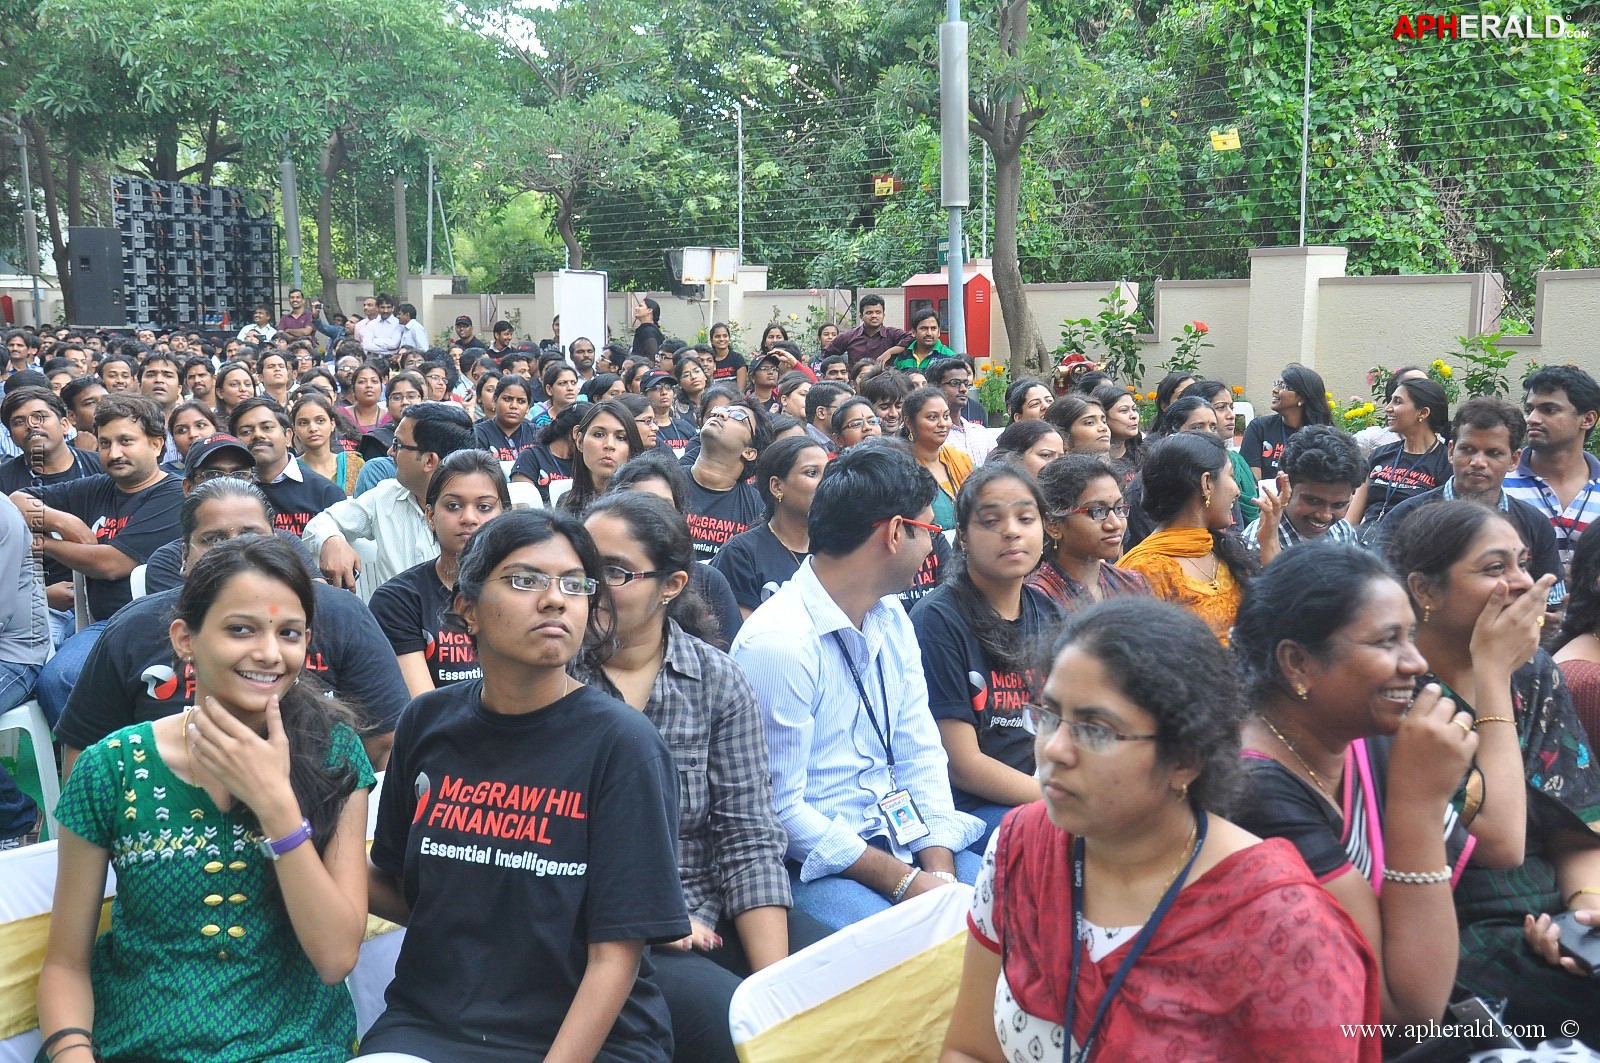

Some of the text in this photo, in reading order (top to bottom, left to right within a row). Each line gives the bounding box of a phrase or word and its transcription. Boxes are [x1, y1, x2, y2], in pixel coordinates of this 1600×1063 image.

[438, 667, 484, 681] Essenti
[438, 775, 587, 820] McGRAW HIL
[427, 802, 552, 845] FINANCIAL
[420, 836, 588, 877] Essential Intelligence
